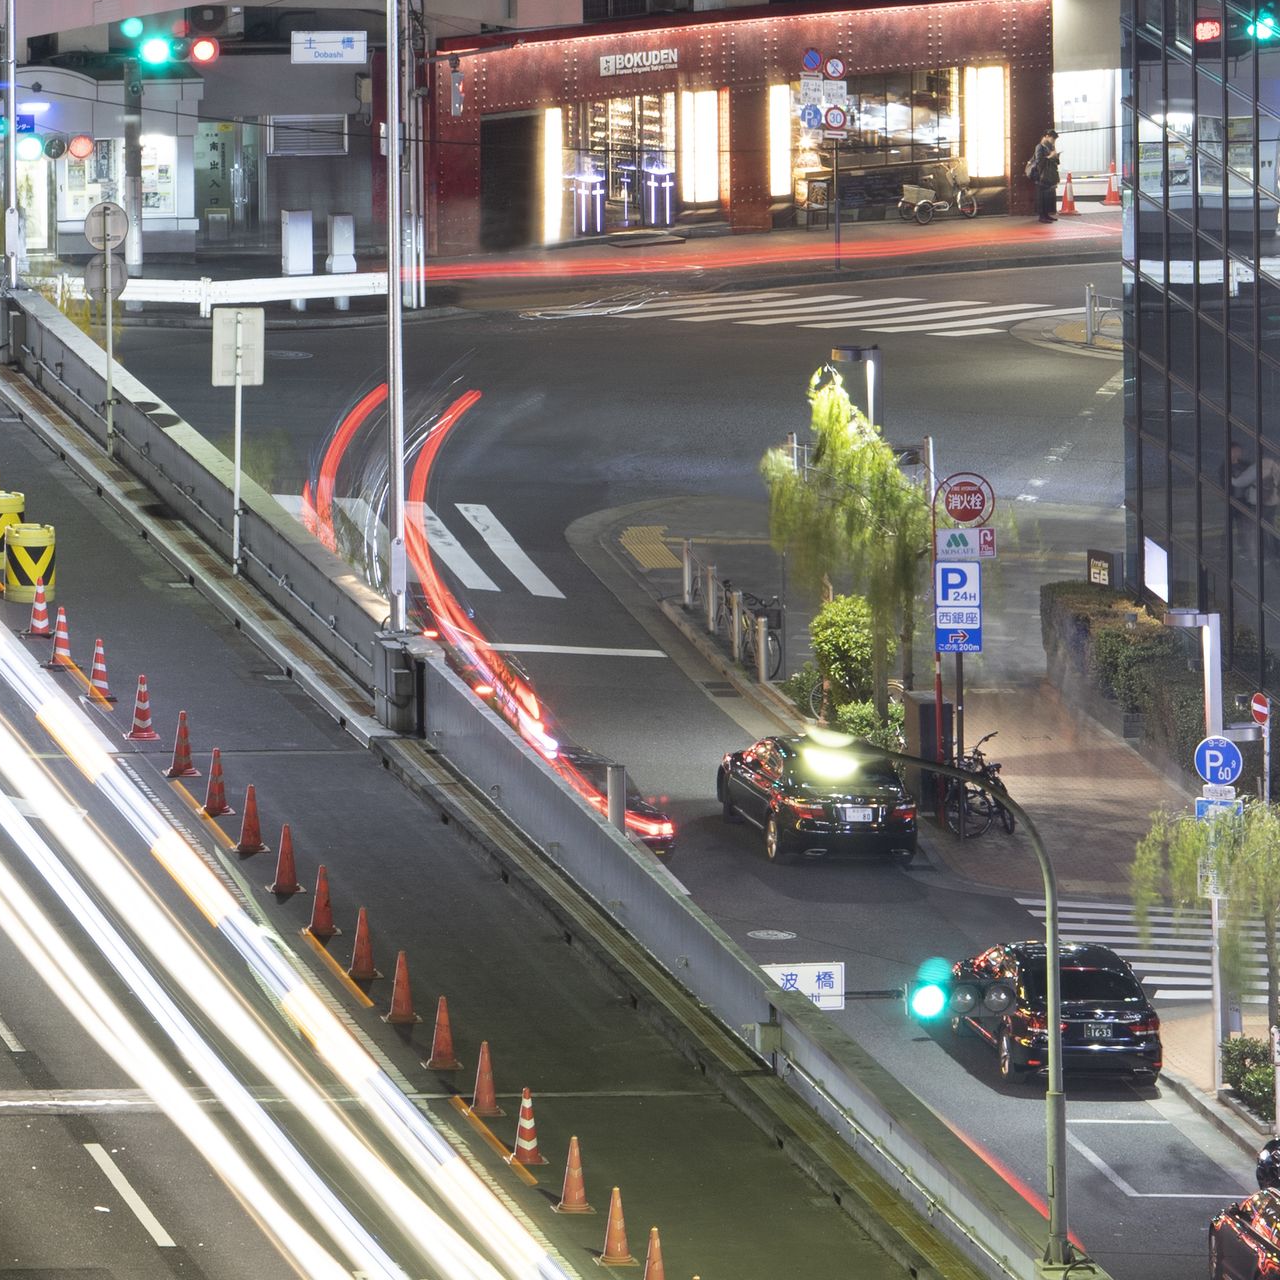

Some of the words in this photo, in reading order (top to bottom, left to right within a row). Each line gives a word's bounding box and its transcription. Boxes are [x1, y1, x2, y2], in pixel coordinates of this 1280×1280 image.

[313, 50, 344, 58] Dobashi
[616, 48, 678, 69] BOKUDEN
[829, 112, 842, 124] 30
[209, 141, 221, 205] 南出入口
[948, 493, 983, 510] 消火栓
[941, 567, 968, 601] P
[952, 591, 977, 602] 24H
[938, 611, 978, 625] 西銀座
[1208, 739, 1227, 748] 9-21
[1205, 749, 1224, 780] P
[780, 970, 835, 991] 波橋
